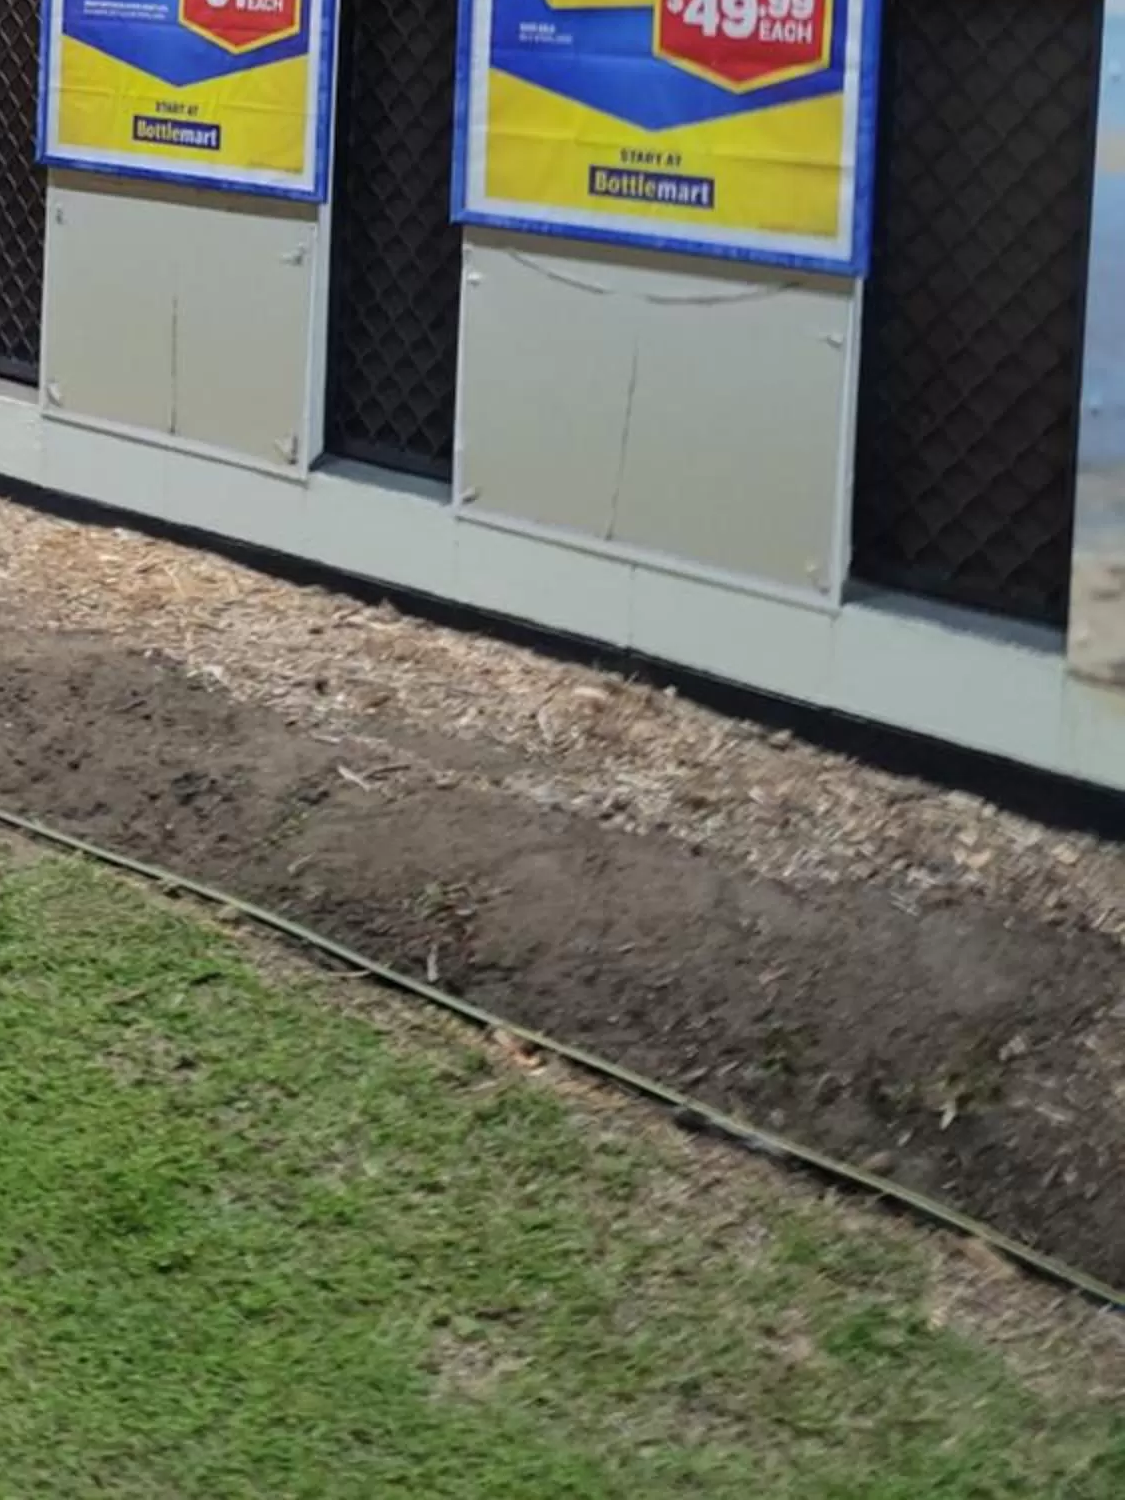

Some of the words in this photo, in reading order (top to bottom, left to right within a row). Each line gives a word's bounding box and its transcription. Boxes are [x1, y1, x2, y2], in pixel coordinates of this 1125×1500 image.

[758, 19, 814, 45] EACH
[136, 118, 218, 148] Bottlemart
[619, 147, 662, 166] START
[665, 152, 683, 168] AT
[594, 169, 711, 206] Bottlemart
